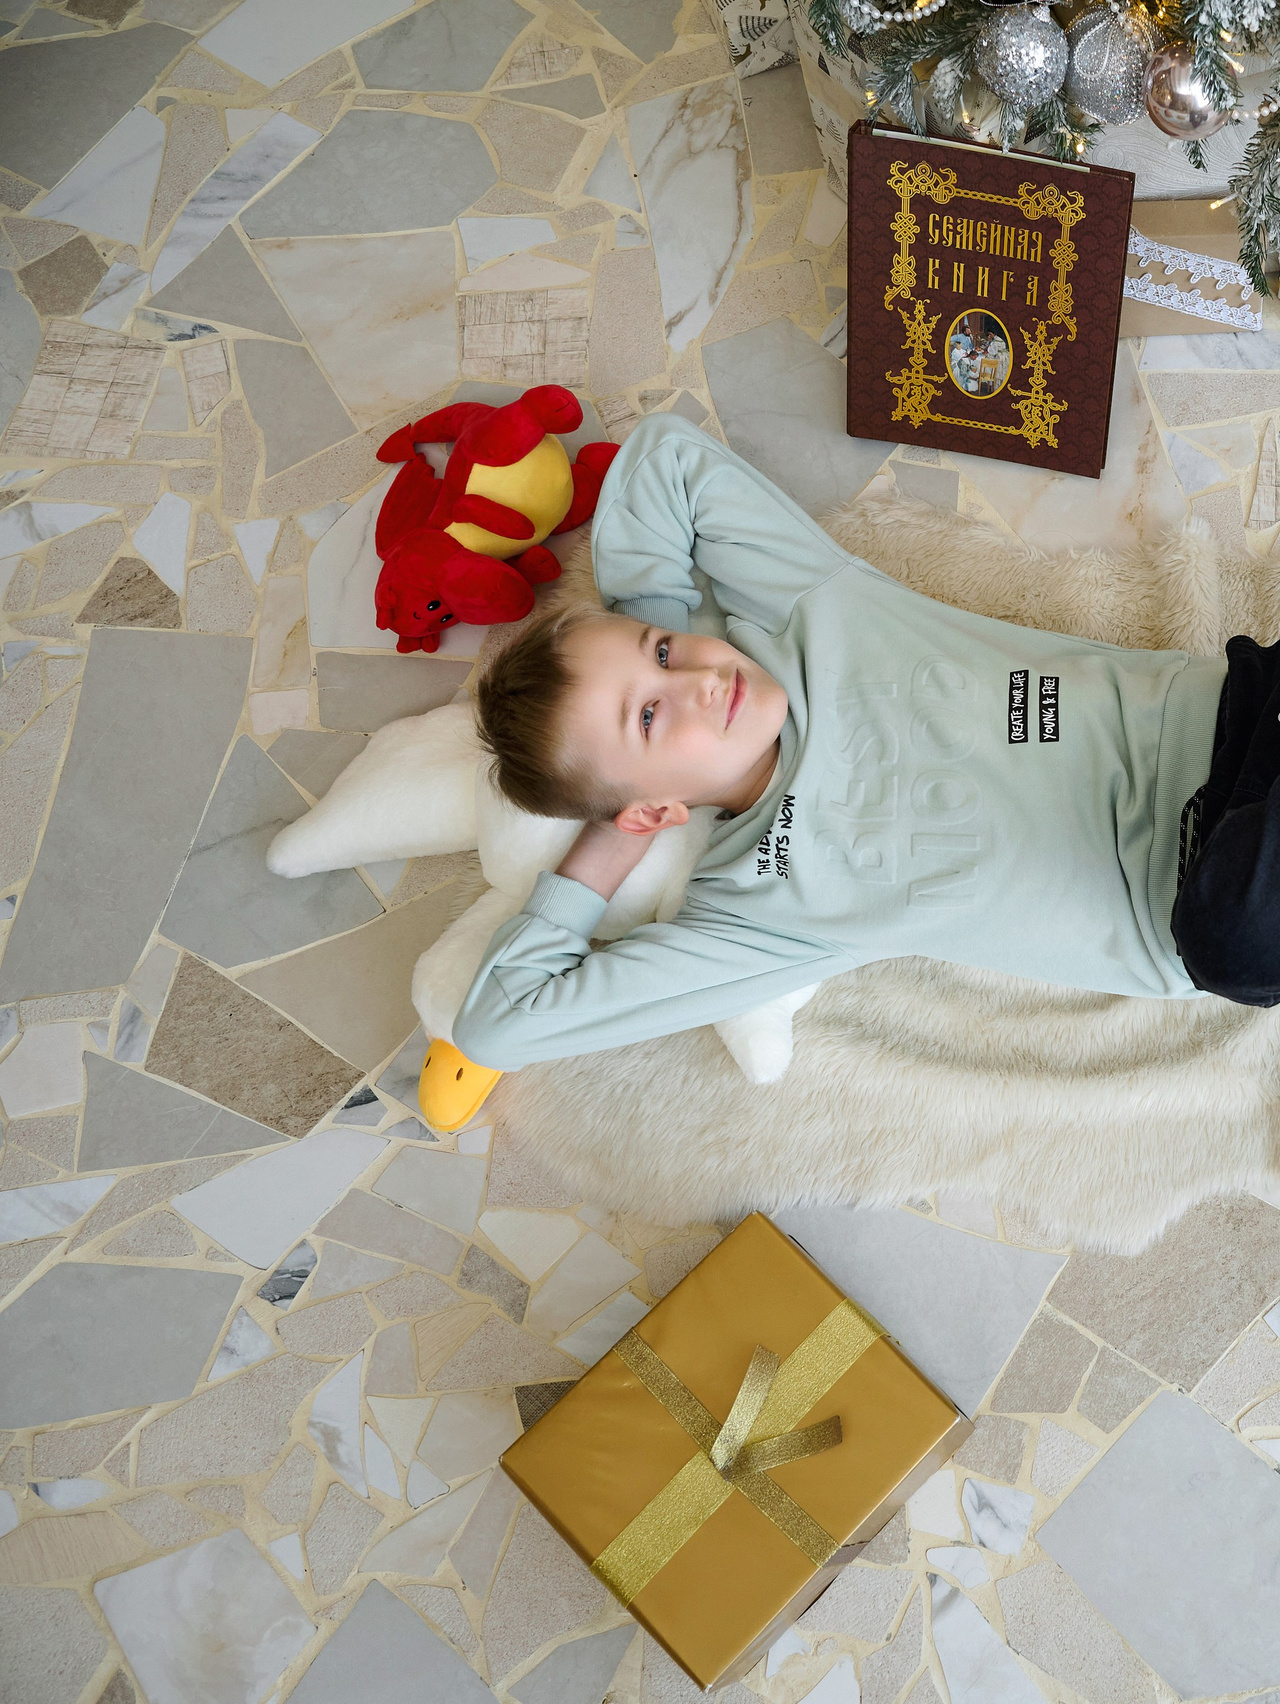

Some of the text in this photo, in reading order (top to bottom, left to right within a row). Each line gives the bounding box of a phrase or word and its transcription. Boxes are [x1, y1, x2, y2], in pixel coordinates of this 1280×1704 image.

[927, 257, 1040, 307] КНИГА
[1012, 671, 1026, 688] LIFE
[1011, 687, 1025, 709] YOUR
[1041, 677, 1057, 740] YOUNG & FREE
[774, 794, 796, 880] STARTS NOW
[757, 858, 772, 876] THE
